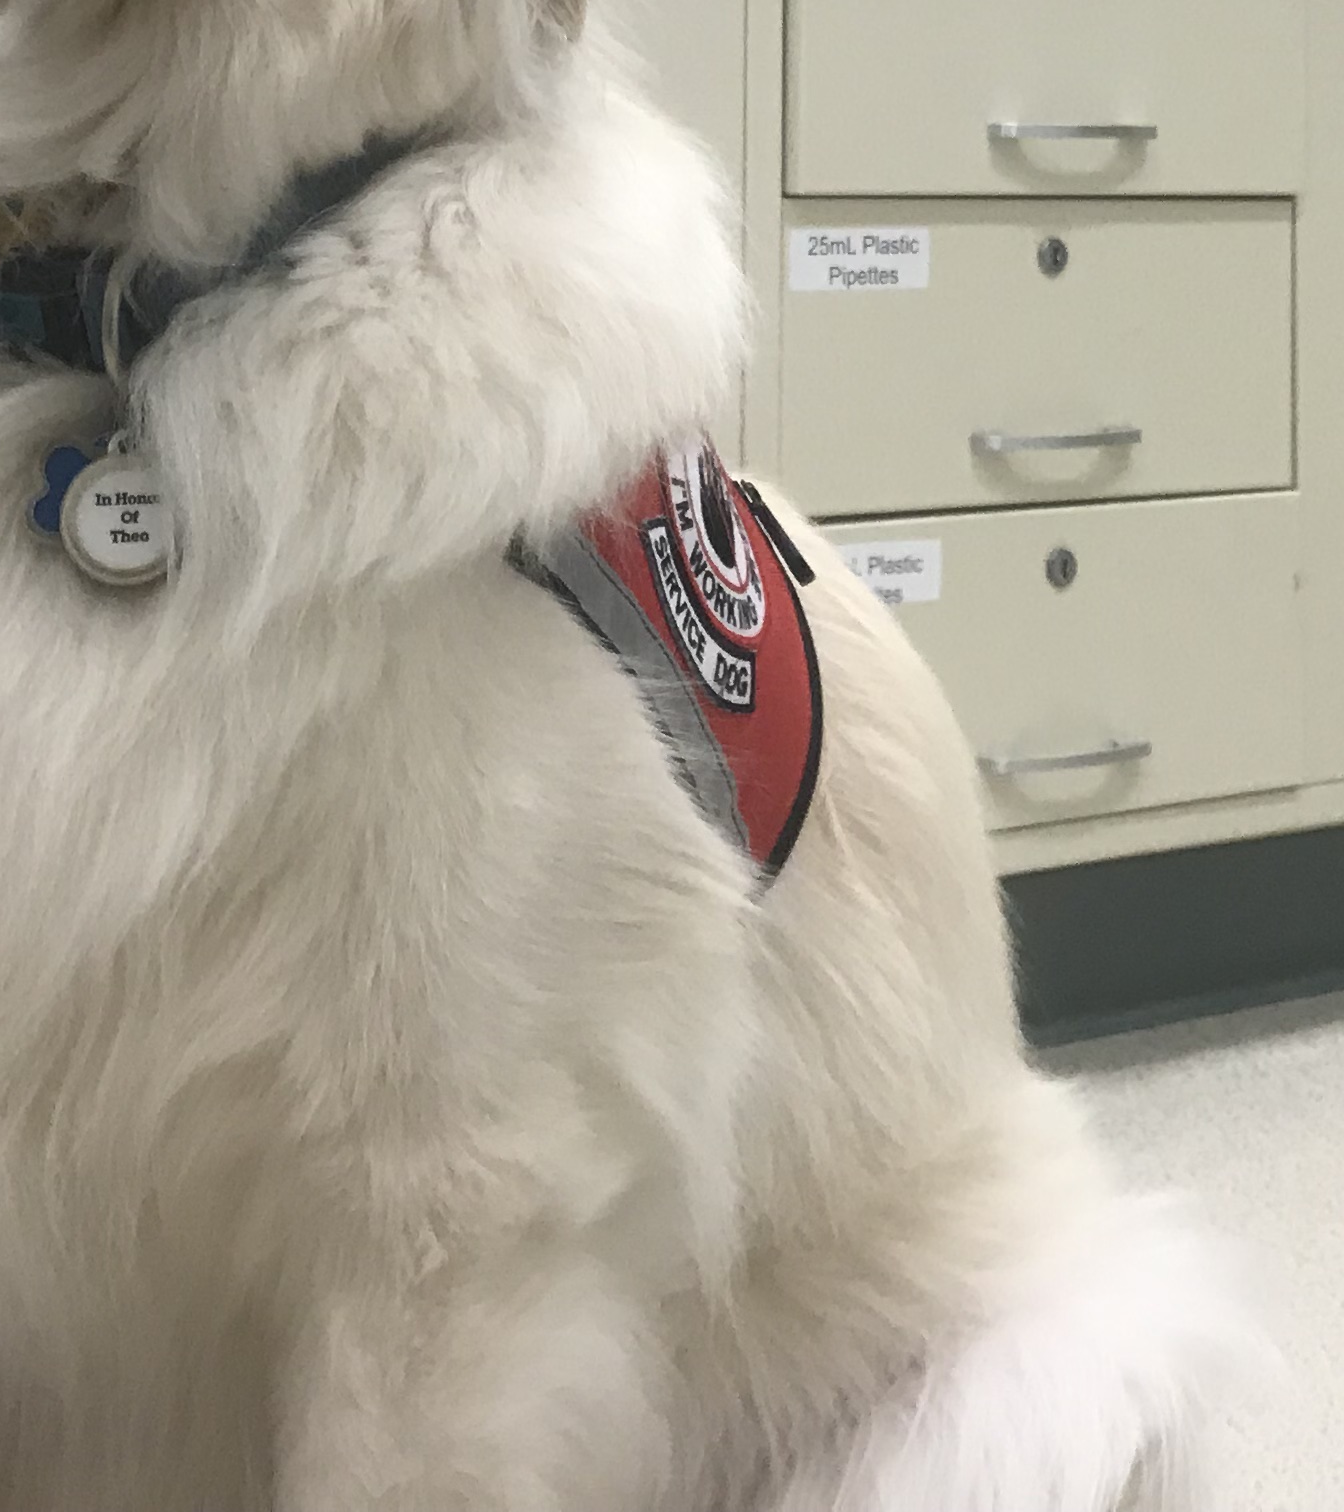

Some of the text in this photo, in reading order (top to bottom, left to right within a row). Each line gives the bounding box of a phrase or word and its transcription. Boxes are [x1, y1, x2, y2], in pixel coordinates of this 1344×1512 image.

[808, 235, 920, 256] 25mL Plastic
[829, 265, 899, 289] Pipettes
[95, 492, 113, 506] In
[120, 509, 140, 524] Of
[110, 529, 150, 544] Theo
[867, 554, 925, 577] Plastic
[689, 540, 759, 631] WORKING
[656, 534, 706, 663] SERVICE
[713, 651, 749, 697] DOG
